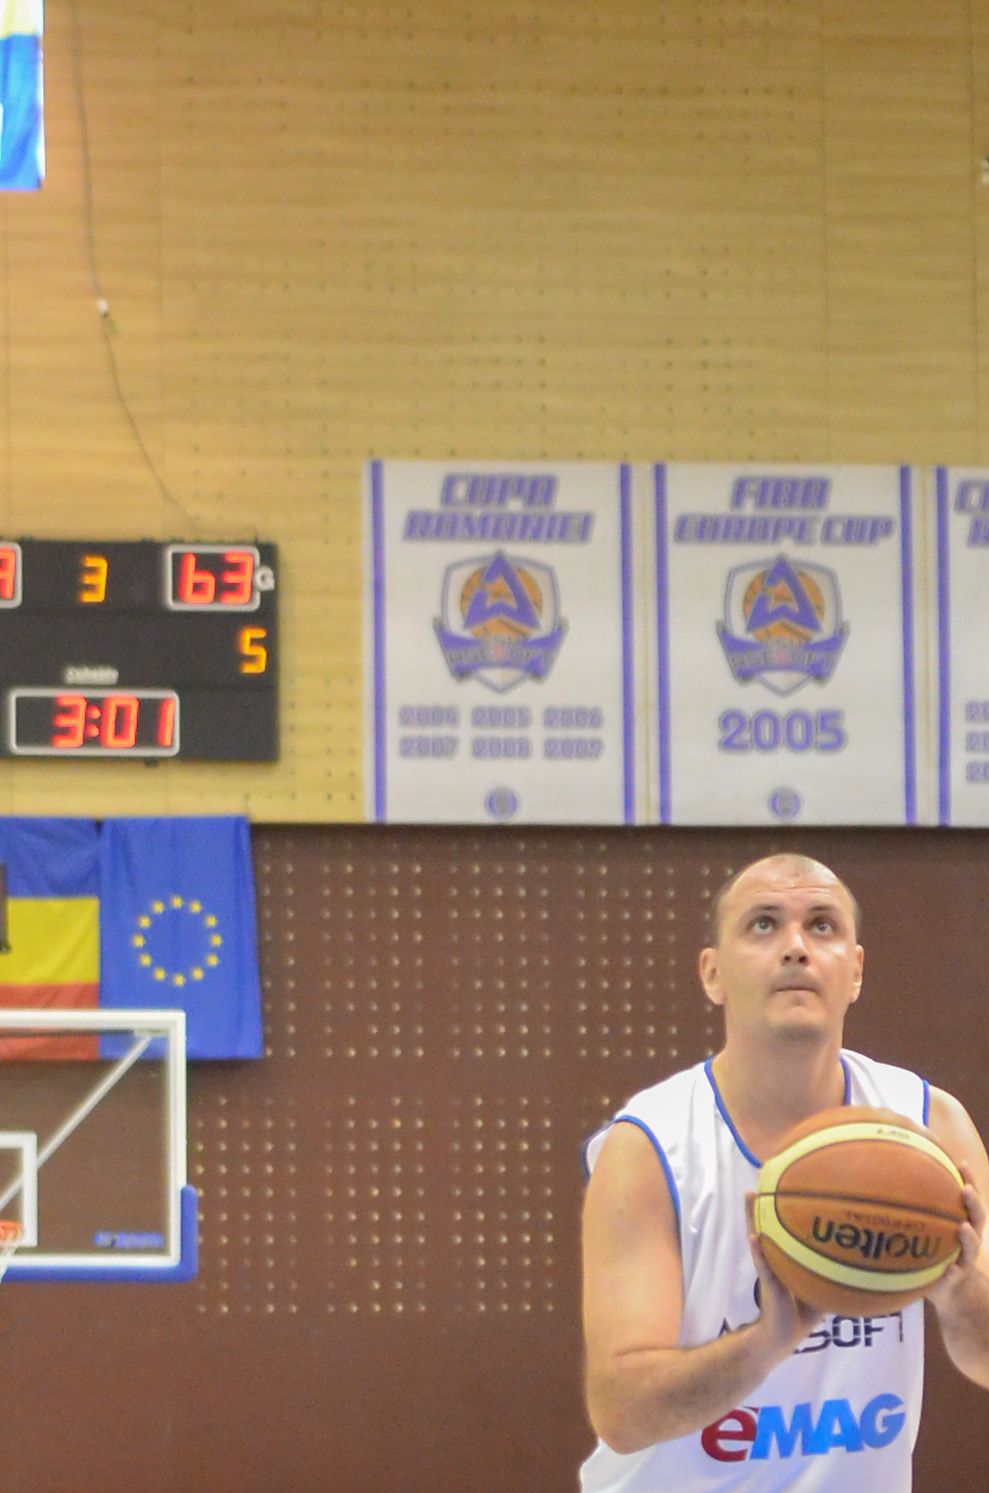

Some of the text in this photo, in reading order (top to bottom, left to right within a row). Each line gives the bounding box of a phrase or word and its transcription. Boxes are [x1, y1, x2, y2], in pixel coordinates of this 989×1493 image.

[821, 516, 895, 546] CUP
[80, 556, 108, 603] 3
[180, 552, 254, 604] 63
[240, 627, 267, 674] 5
[53, 695, 175, 748] 3:01
[717, 709, 848, 754] 2005
[812, 1216, 942, 1260] molten
[701, 1393, 907, 1463] eMAG
